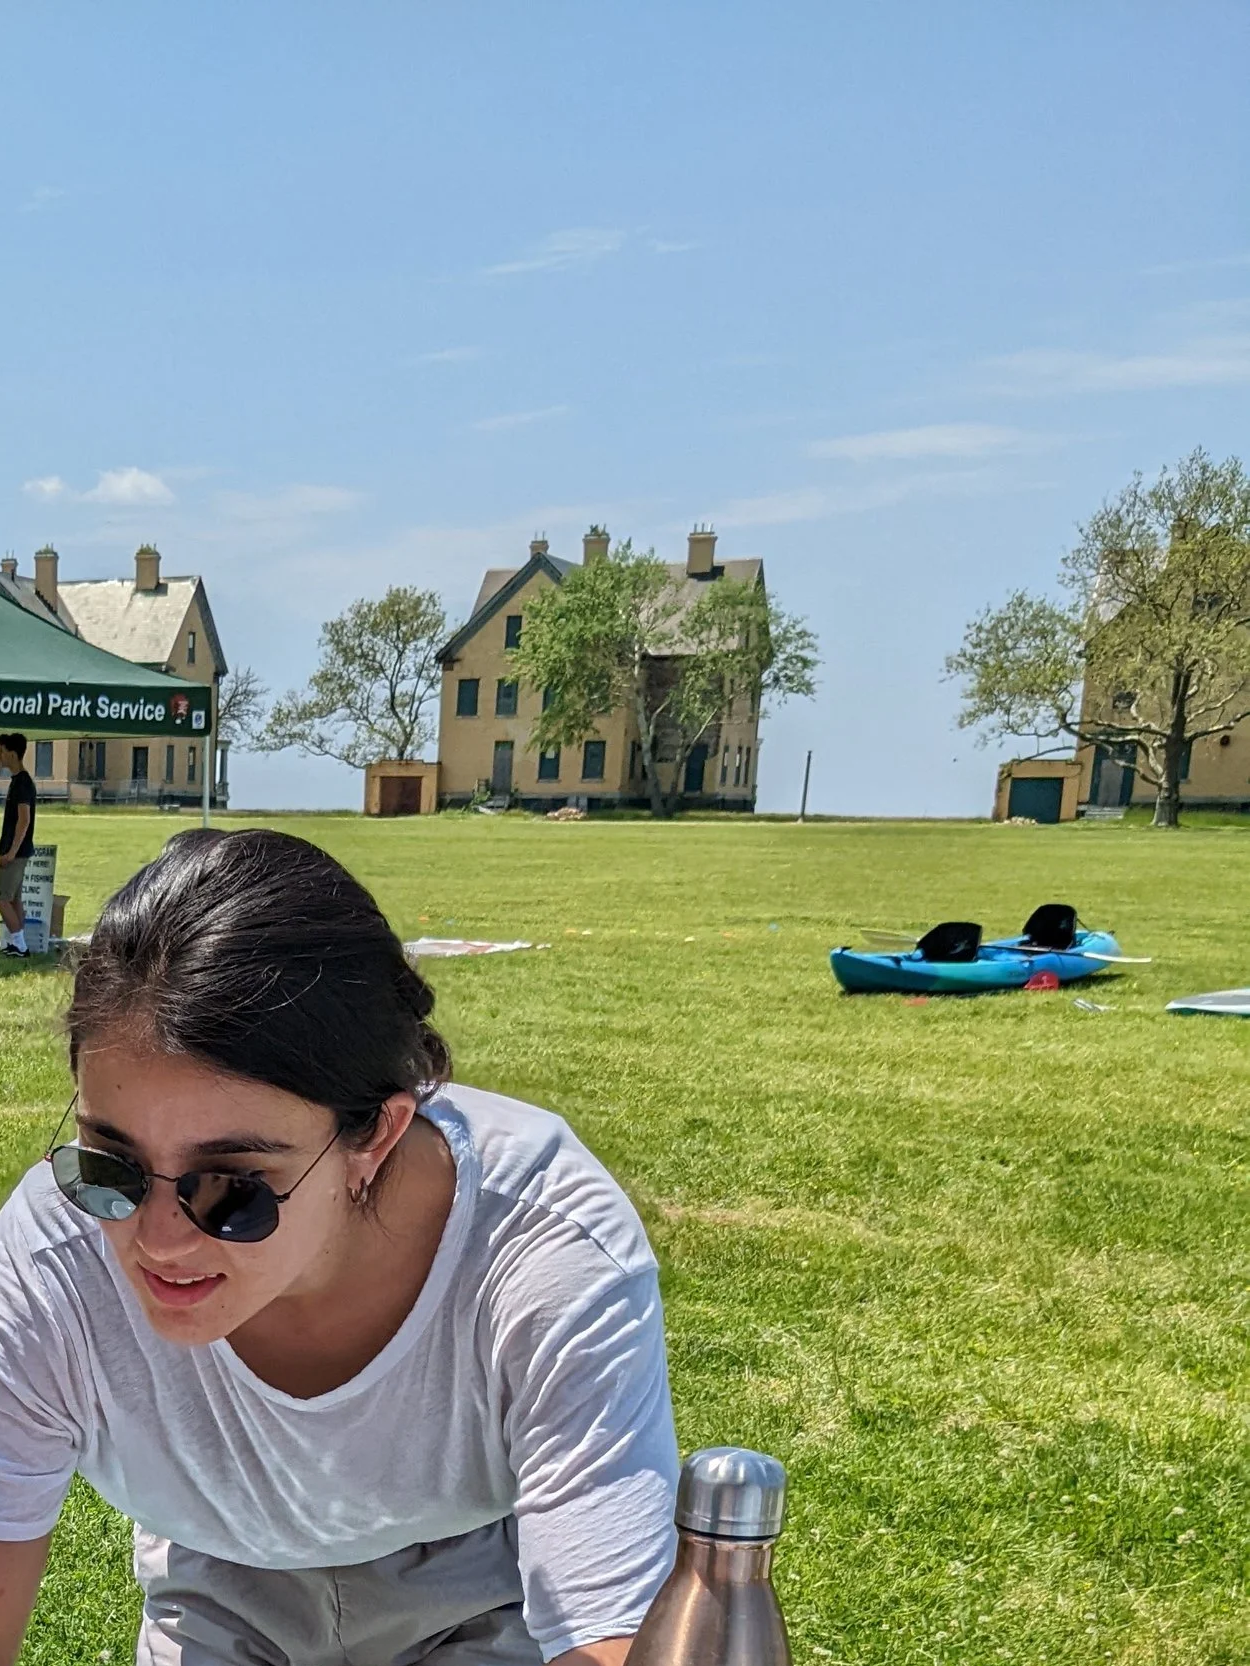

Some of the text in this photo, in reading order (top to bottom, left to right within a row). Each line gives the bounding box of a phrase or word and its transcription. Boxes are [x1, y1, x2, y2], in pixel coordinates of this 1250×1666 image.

[47, 693, 92, 717] Park
[96, 695, 165, 722] Service
[21, 886, 41, 895] CLINIC
